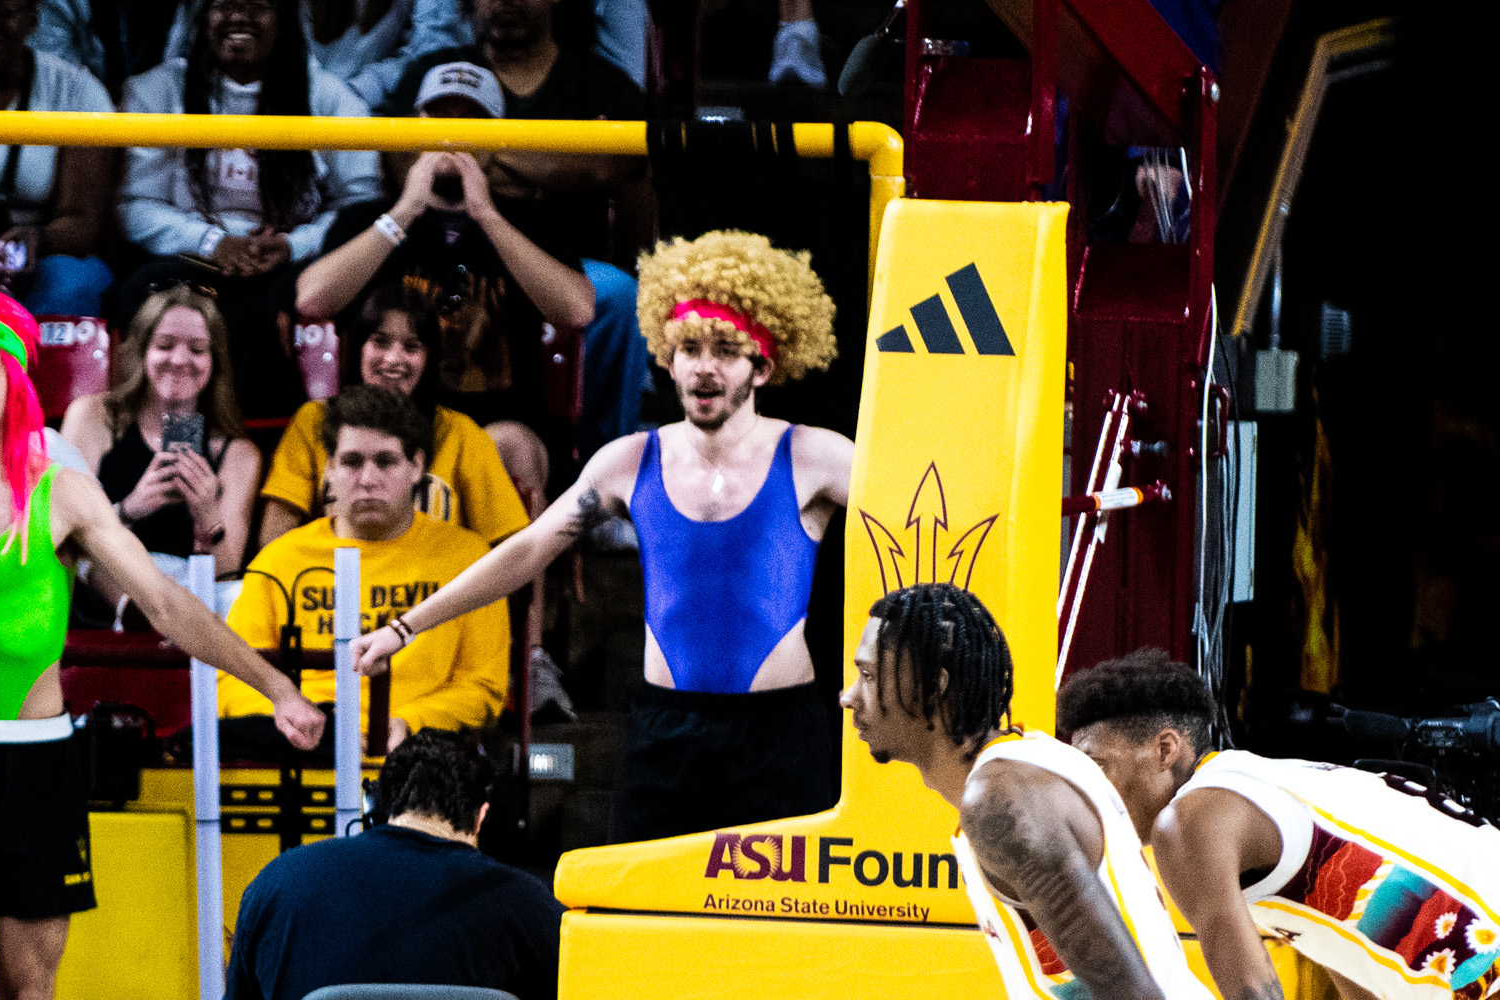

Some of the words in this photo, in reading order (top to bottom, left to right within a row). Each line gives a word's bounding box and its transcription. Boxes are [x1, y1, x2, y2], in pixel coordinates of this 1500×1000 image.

[301, 585, 337, 611] SU
[704, 832, 807, 883] ASU
[818, 836, 960, 890] Foun
[703, 893, 776, 913] Arizona
[780, 897, 831, 915] State
[834, 900, 931, 922] University
